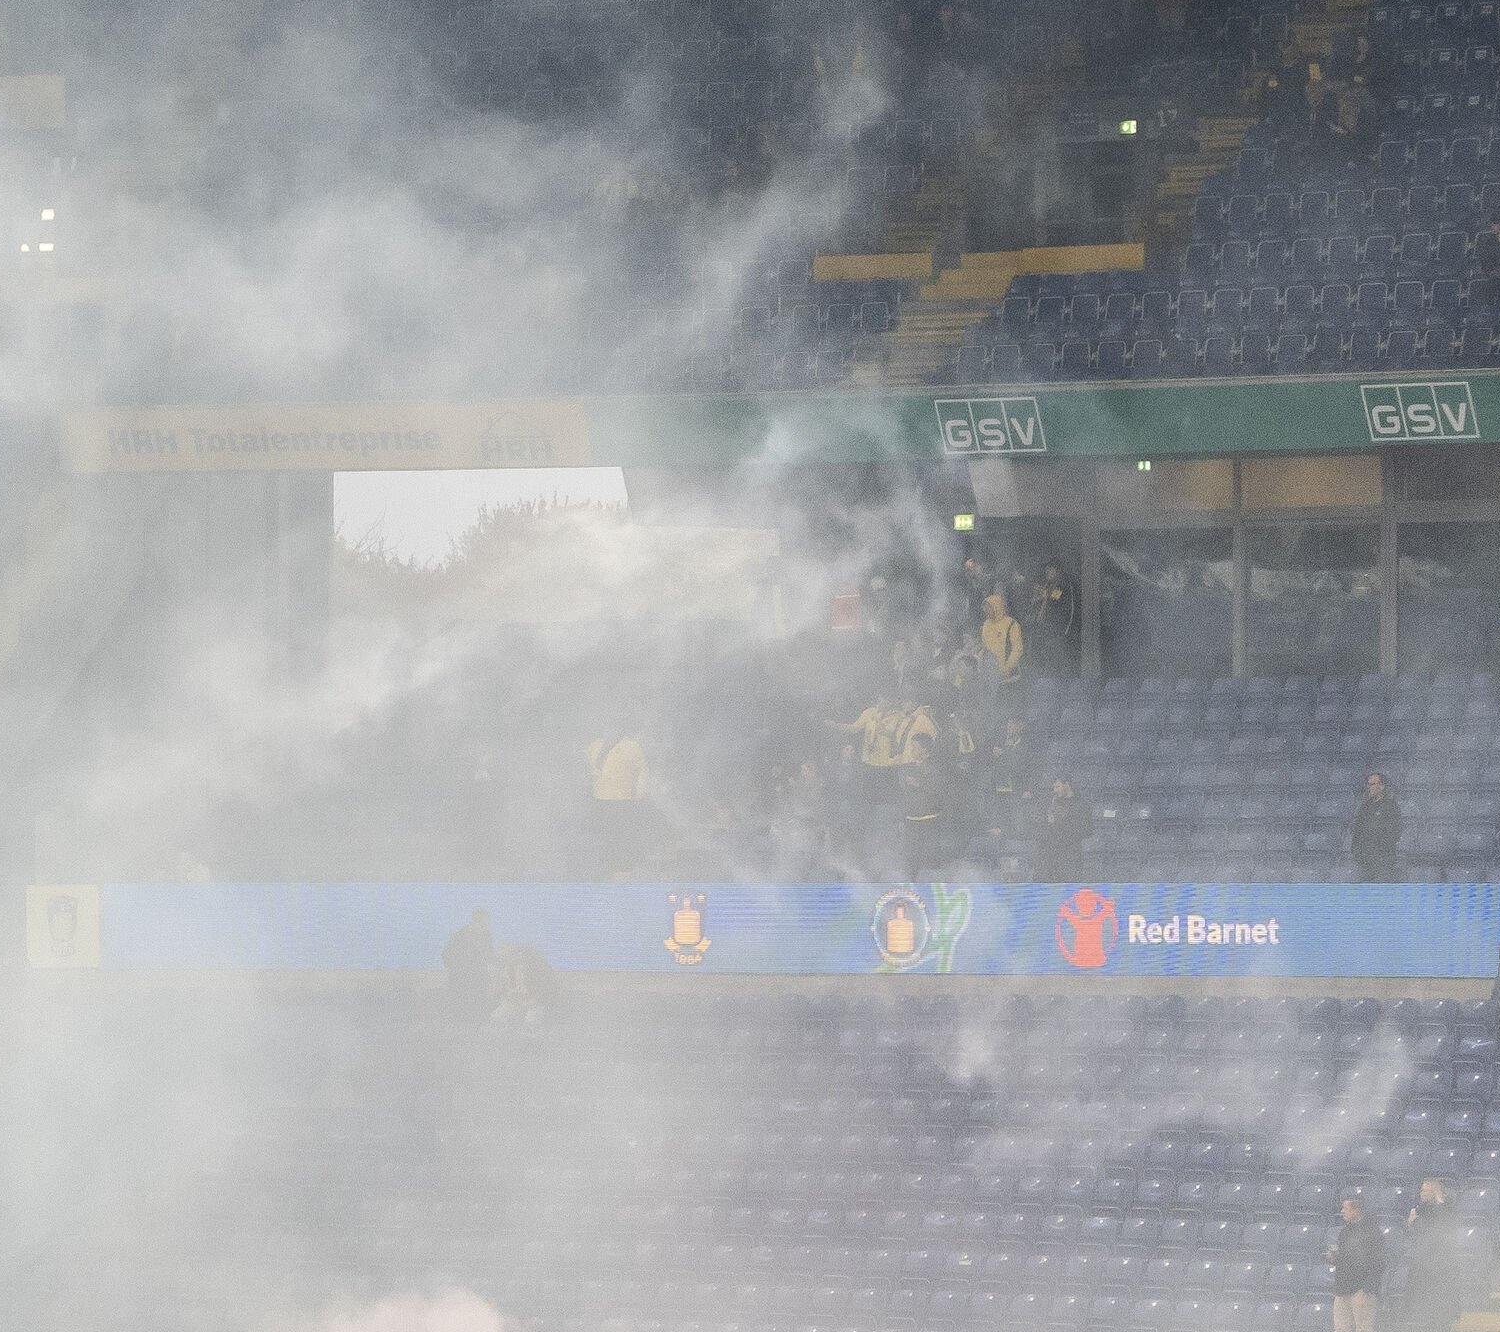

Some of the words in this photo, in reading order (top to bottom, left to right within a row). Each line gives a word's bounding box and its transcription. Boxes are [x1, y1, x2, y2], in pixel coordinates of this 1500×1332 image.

[945, 416, 1037, 449] GSV
[1371, 402, 1468, 435] GSV
[1128, 914, 1180, 944] Red
[1187, 915, 1279, 945] Barnet
